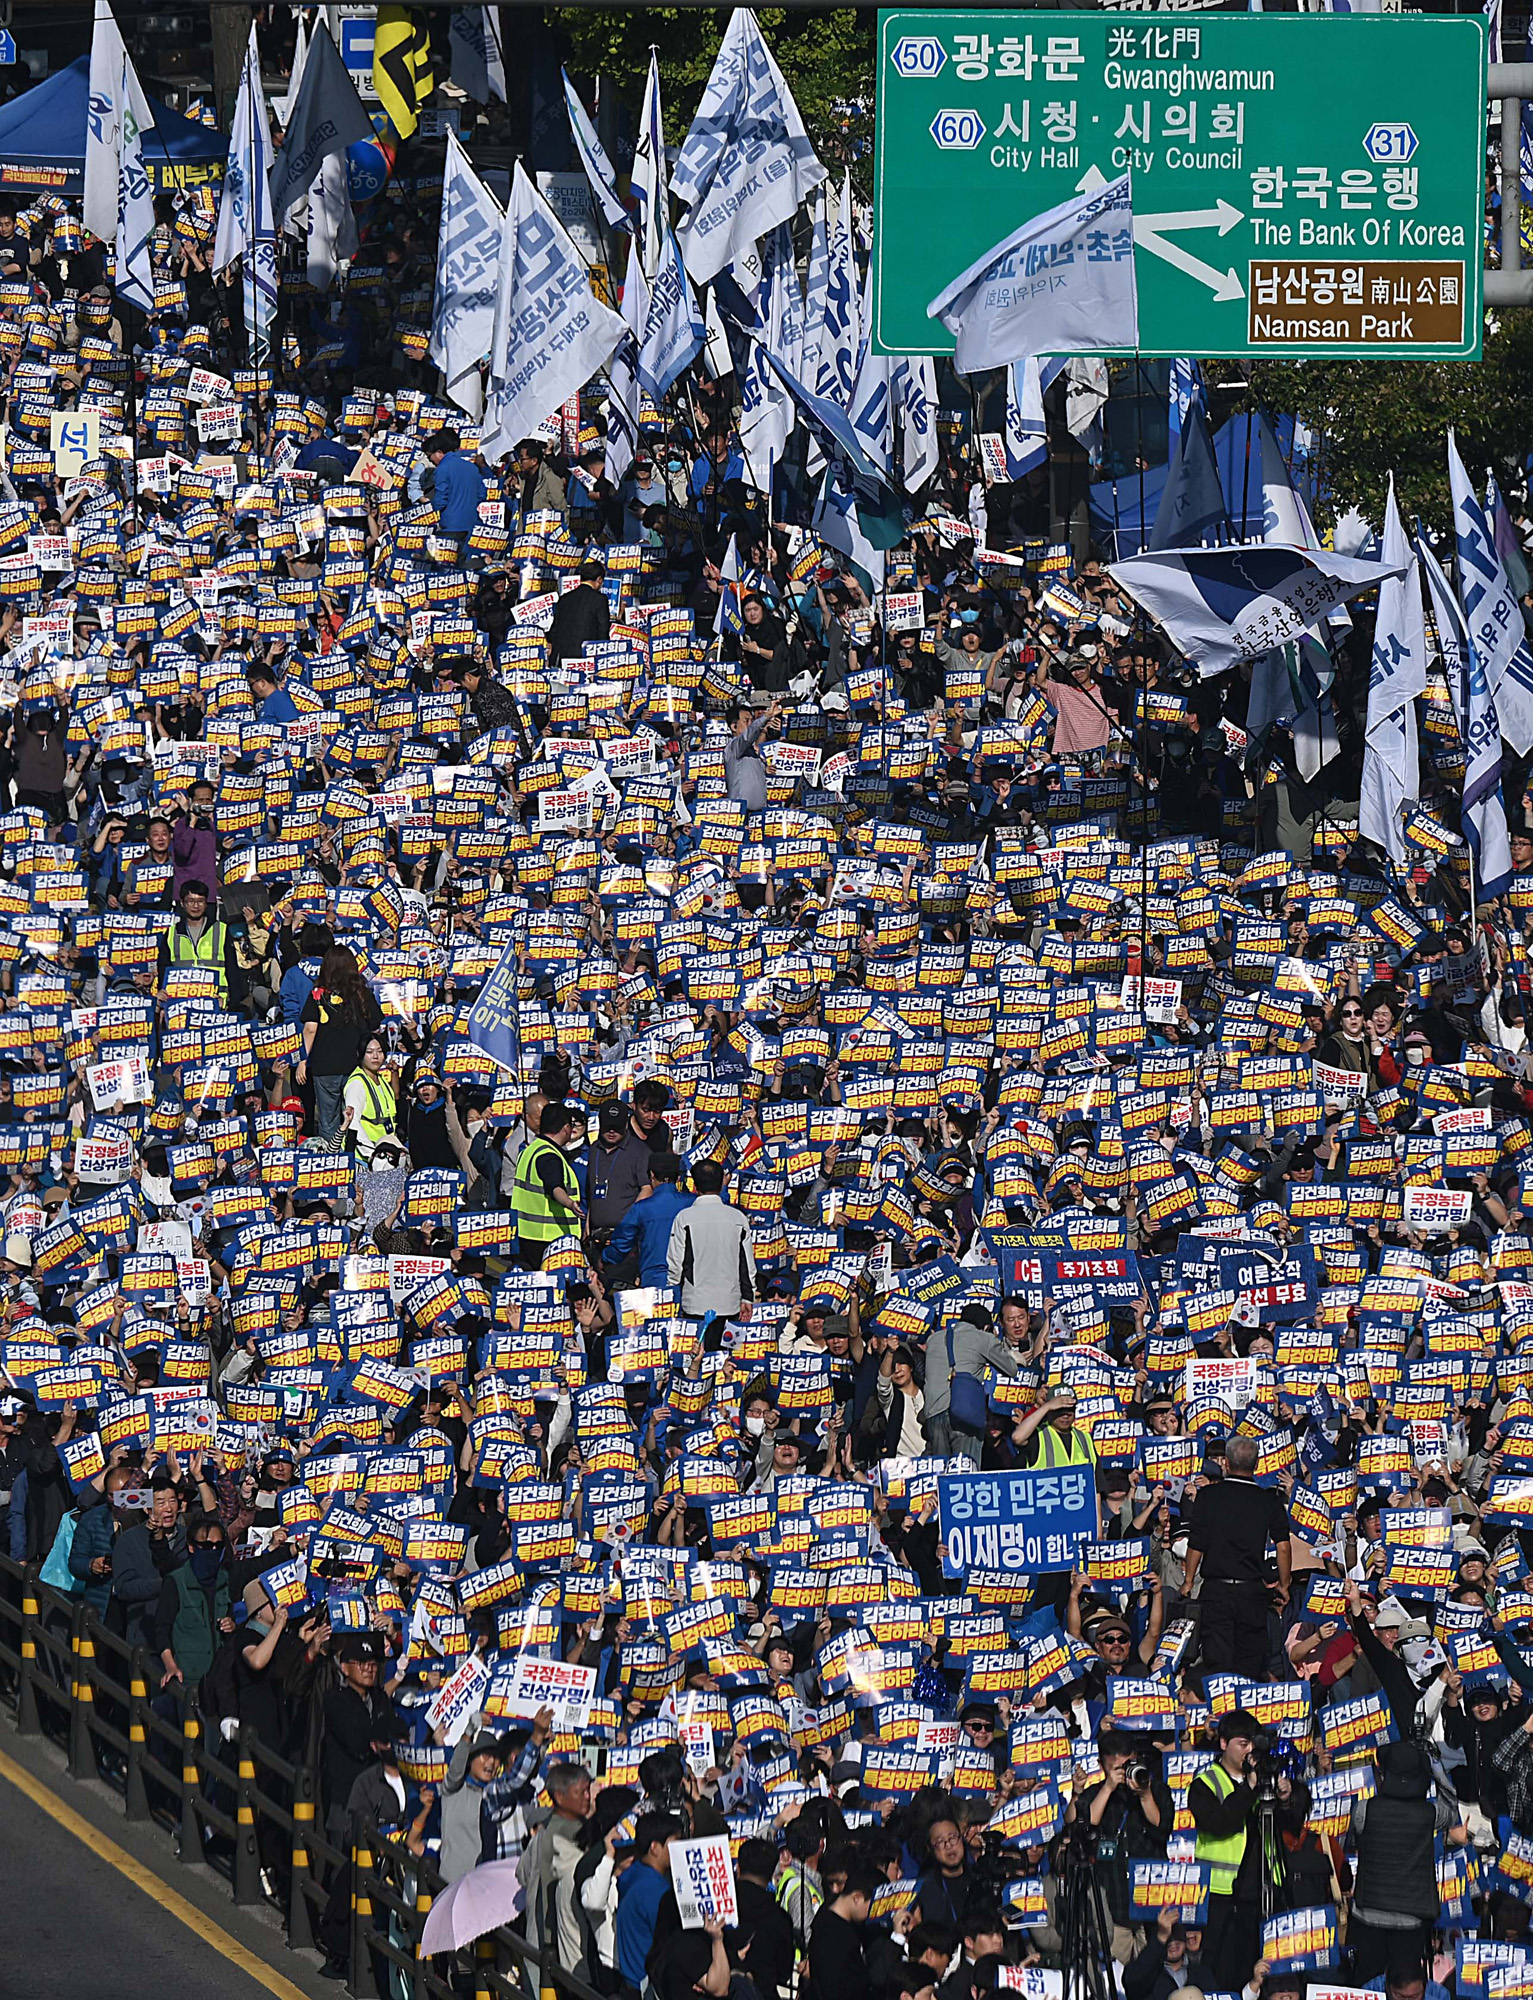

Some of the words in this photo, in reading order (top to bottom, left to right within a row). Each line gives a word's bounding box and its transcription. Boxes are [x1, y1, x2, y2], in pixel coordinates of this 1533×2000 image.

[1108, 27, 1201, 59] 光化門
[902, 44, 937, 70] 50
[951, 34, 1085, 81] 광화문
[1104, 62, 1275, 98] Gwanghwamun
[941, 116, 977, 142] 60
[1374, 130, 1408, 156] 31
[990, 146, 1032, 172] City
[1041, 146, 1079, 169] Hall
[1111, 148, 1153, 172] City
[1166, 147, 1242, 170] Council
[1250, 166, 1418, 210] 한국은행
[1250, 219, 1291, 246] The
[1298, 219, 1355, 246] Bank
[1363, 218, 1394, 246] Of
[1399, 219, 1464, 246] Korea
[1254, 268, 1364, 305] 남산공원
[1371, 278, 1458, 305] 南山公園
[1253, 314, 1349, 339] Namsan
[1361, 315, 1413, 339] Park
[200, 408, 235, 424] 국정농단
[201, 419, 239, 432] 진상규명!
[778, 745, 818, 760] 국정농단
[543, 792, 589, 807] 국정농단
[543, 805, 591, 820] 진상규명!
[457, 832, 505, 848] 김건희를
[877, 823, 923, 840] 김건희를
[256, 845, 299, 862] 김건희를
[257, 855, 305, 874] 특검하라!
[34, 874, 83, 889] 김건희를
[34, 888, 87, 903] 특검하라!
[1308, 899, 1356, 912] 김건희를
[688, 972, 737, 986] 김건희를
[688, 984, 739, 999] 특검하라!
[99, 1009, 146, 1026] 김건희를
[1096, 1013, 1143, 1032] 김건희를
[251, 1023, 297, 1045] 김건희를
[782, 1028, 830, 1043] 김건희를
[1241, 1057, 1292, 1072] 김건희를
[1316, 1067, 1362, 1085] 국정농단
[1210, 1092, 1261, 1109] 김건희를
[810, 1109, 860, 1126] 김건희를
[1210, 1106, 1264, 1125] 특검하라!
[81, 1141, 129, 1159] 국정농단
[1446, 1135, 1498, 1151] 김건희를
[299, 1156, 349, 1173] 김건희를
[1445, 1151, 1500, 1166] 특검하라!
[297, 1171, 354, 1189] 특검하라!
[210, 1189, 261, 1204] 김건희를
[408, 1183, 455, 1197] 김건희를
[1144, 1176, 1188, 1203] 김건희를
[1291, 1185, 1341, 1199] 김건희를
[212, 1199, 269, 1215] 특검하라!
[1289, 1200, 1347, 1216] 특검하라!
[1410, 1192, 1465, 1207] 국정농단
[457, 1214, 510, 1231] 김건희를
[1410, 1208, 1467, 1222] 진상규명!
[457, 1227, 516, 1247] 특검하라!
[123, 1255, 176, 1273] 김건희를
[1063, 1261, 1119, 1277] 주가조작
[1098, 1282, 1139, 1298] 구속하라
[1275, 1284, 1307, 1304] 무효
[1364, 1280, 1420, 1295] 김건희를
[1360, 1295, 1425, 1311] 특검하라!
[496, 1336, 554, 1352] 김건희를
[1279, 1331, 1333, 1348] 김건희를
[495, 1352, 559, 1369] 특검하라!
[1276, 1347, 1338, 1365] 특검하라!
[34, 1368, 93, 1387] 김건희를
[1193, 1362, 1250, 1379] 국정농단
[37, 1381, 102, 1400] 특검하라!
[782, 1372, 828, 1391] 김건희를
[1192, 1377, 1253, 1395] 진상규명!
[226, 1386, 276, 1405] 김건희를
[1395, 1386, 1446, 1403] 김건희를
[226, 1404, 282, 1422] 특검하라!
[1392, 1403, 1451, 1419] 특검하라!
[949, 1482, 1001, 1518] 강한
[1010, 1474, 1086, 1516] 민주당
[710, 1497, 768, 1520] 김건희를
[712, 1515, 776, 1538] 특검하라!
[1385, 1510, 1443, 1529] 김건희를
[409, 1523, 465, 1541] 김건희를
[1385, 1530, 1450, 1547] 특검하라!
[406, 1540, 466, 1560] 특검하라!
[948, 1522, 1042, 1569] 이재명이
[1087, 1541, 1142, 1561] 김건희를
[1087, 1556, 1148, 1578] 특검하라!
[1393, 1549, 1452, 1567] 김건희를
[459, 1562, 516, 1599] 김건희를
[828, 1567, 882, 1587] 김건희를
[1388, 1567, 1456, 1585] 특검하라!
[828, 1584, 887, 1604] 특검하라!
[498, 1610, 552, 1630] 김건희를
[665, 1603, 724, 1634] 김건희를
[950, 1616, 1004, 1635] 김건희를
[669, 1615, 736, 1652] 특검하라!
[972, 1653, 1024, 1671] 김건희를
[522, 1663, 589, 1686] 국정농단
[518, 1682, 587, 1705] 진상규명!
[1112, 1679, 1169, 1697] 김건희를
[1112, 1696, 1178, 1716] 특검하라!
[1322, 1695, 1380, 1730] 김건희를
[1012, 1721, 1066, 1743] 김건희를
[1324, 1710, 1391, 1748] 특검하라!
[866, 1750, 931, 1769] 김건희를
